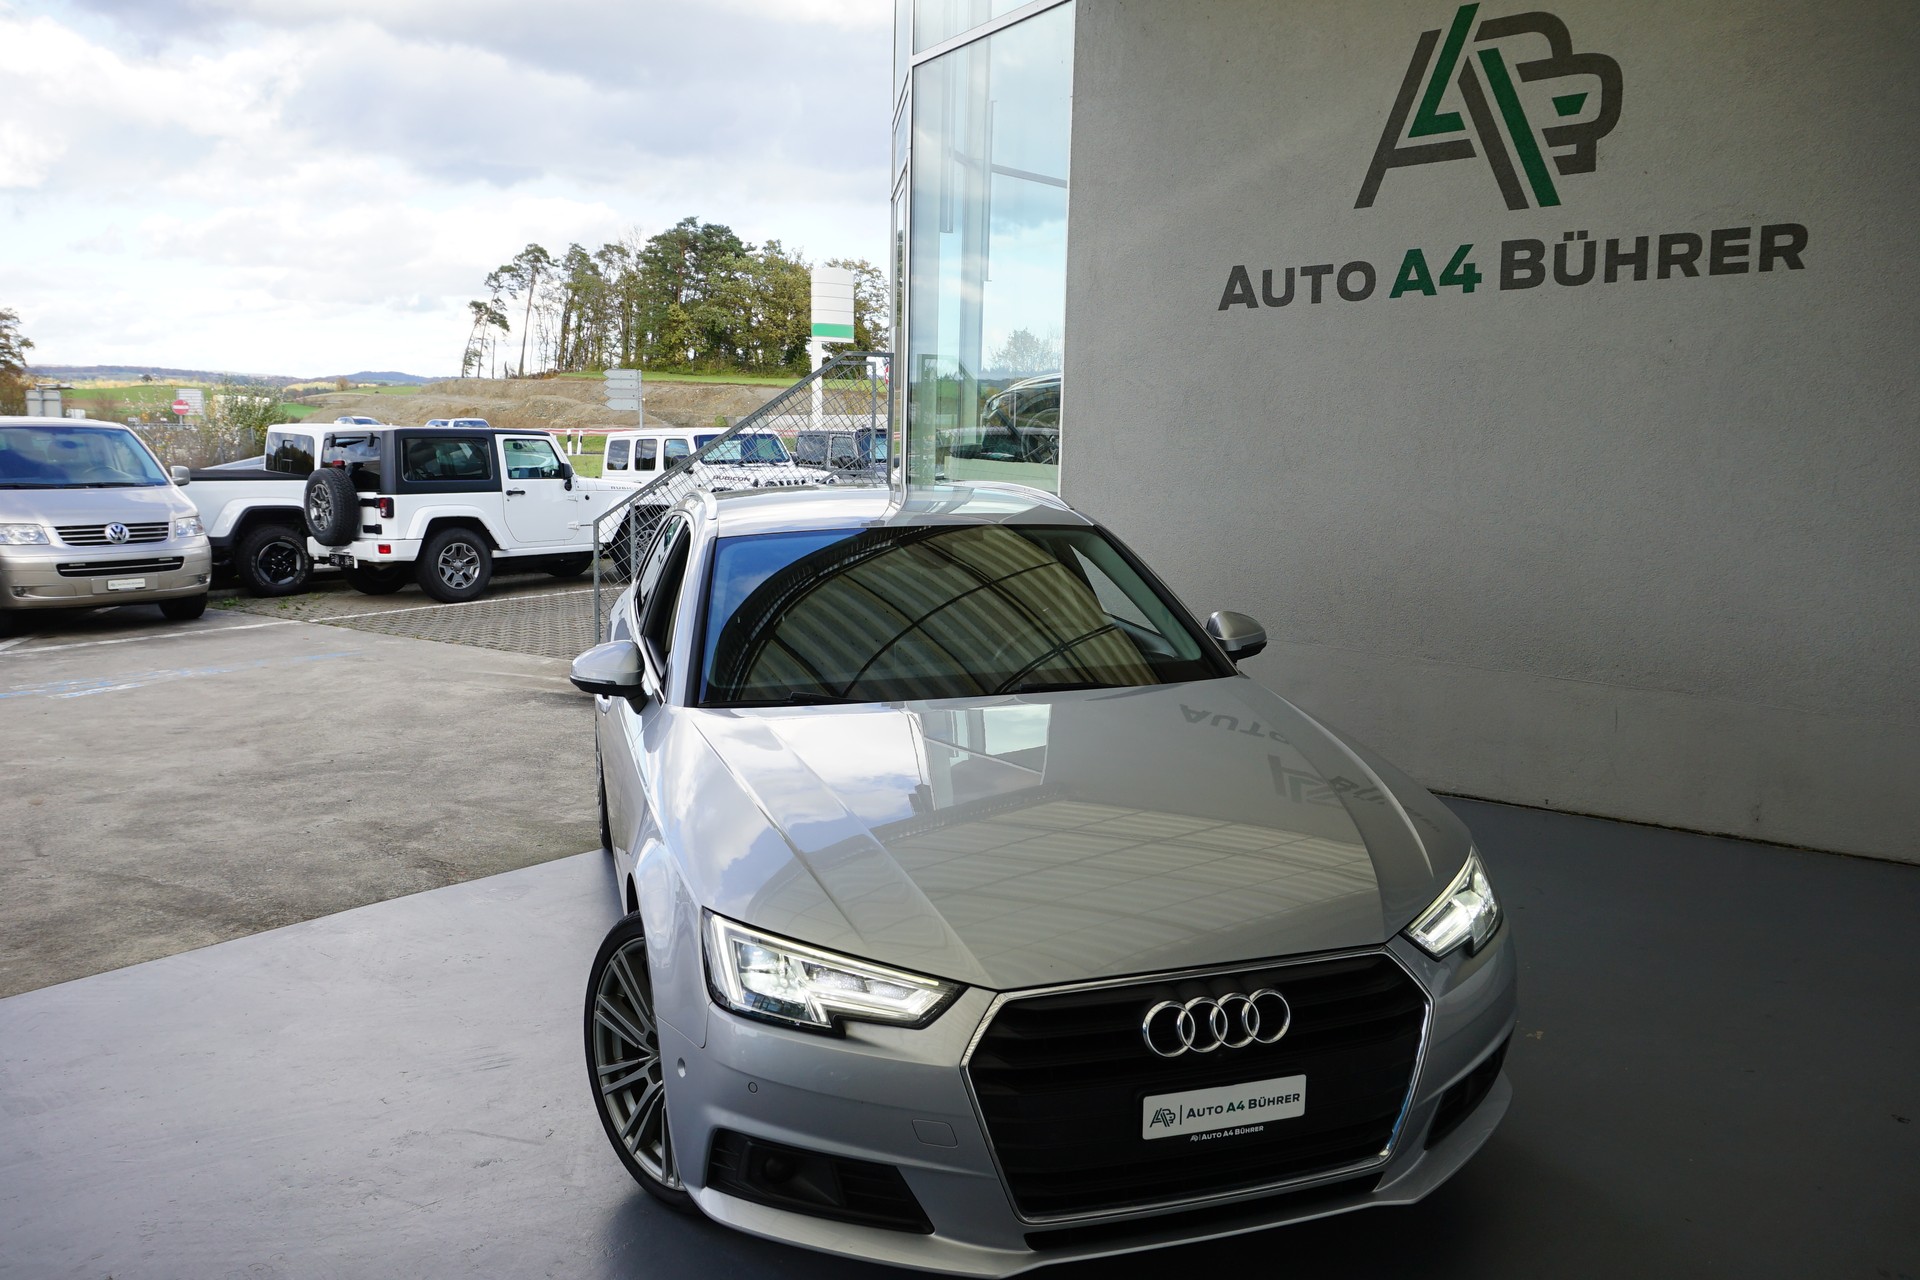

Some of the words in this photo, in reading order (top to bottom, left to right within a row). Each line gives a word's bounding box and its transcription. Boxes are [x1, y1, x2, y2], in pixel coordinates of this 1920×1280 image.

[1218, 260, 1377, 311] AUTO
[1389, 243, 1482, 299] A4
[1499, 222, 1810, 291] BÜHRER
[1186, 1105, 1224, 1119] AUTO
[1226, 1100, 1245, 1113] A4
[1248, 1093, 1301, 1110] BÜHRER
[1201, 1131, 1222, 1141] AUTO
[1222, 1129, 1234, 1138] A4
[1234, 1125, 1264, 1136] BÜHRER
